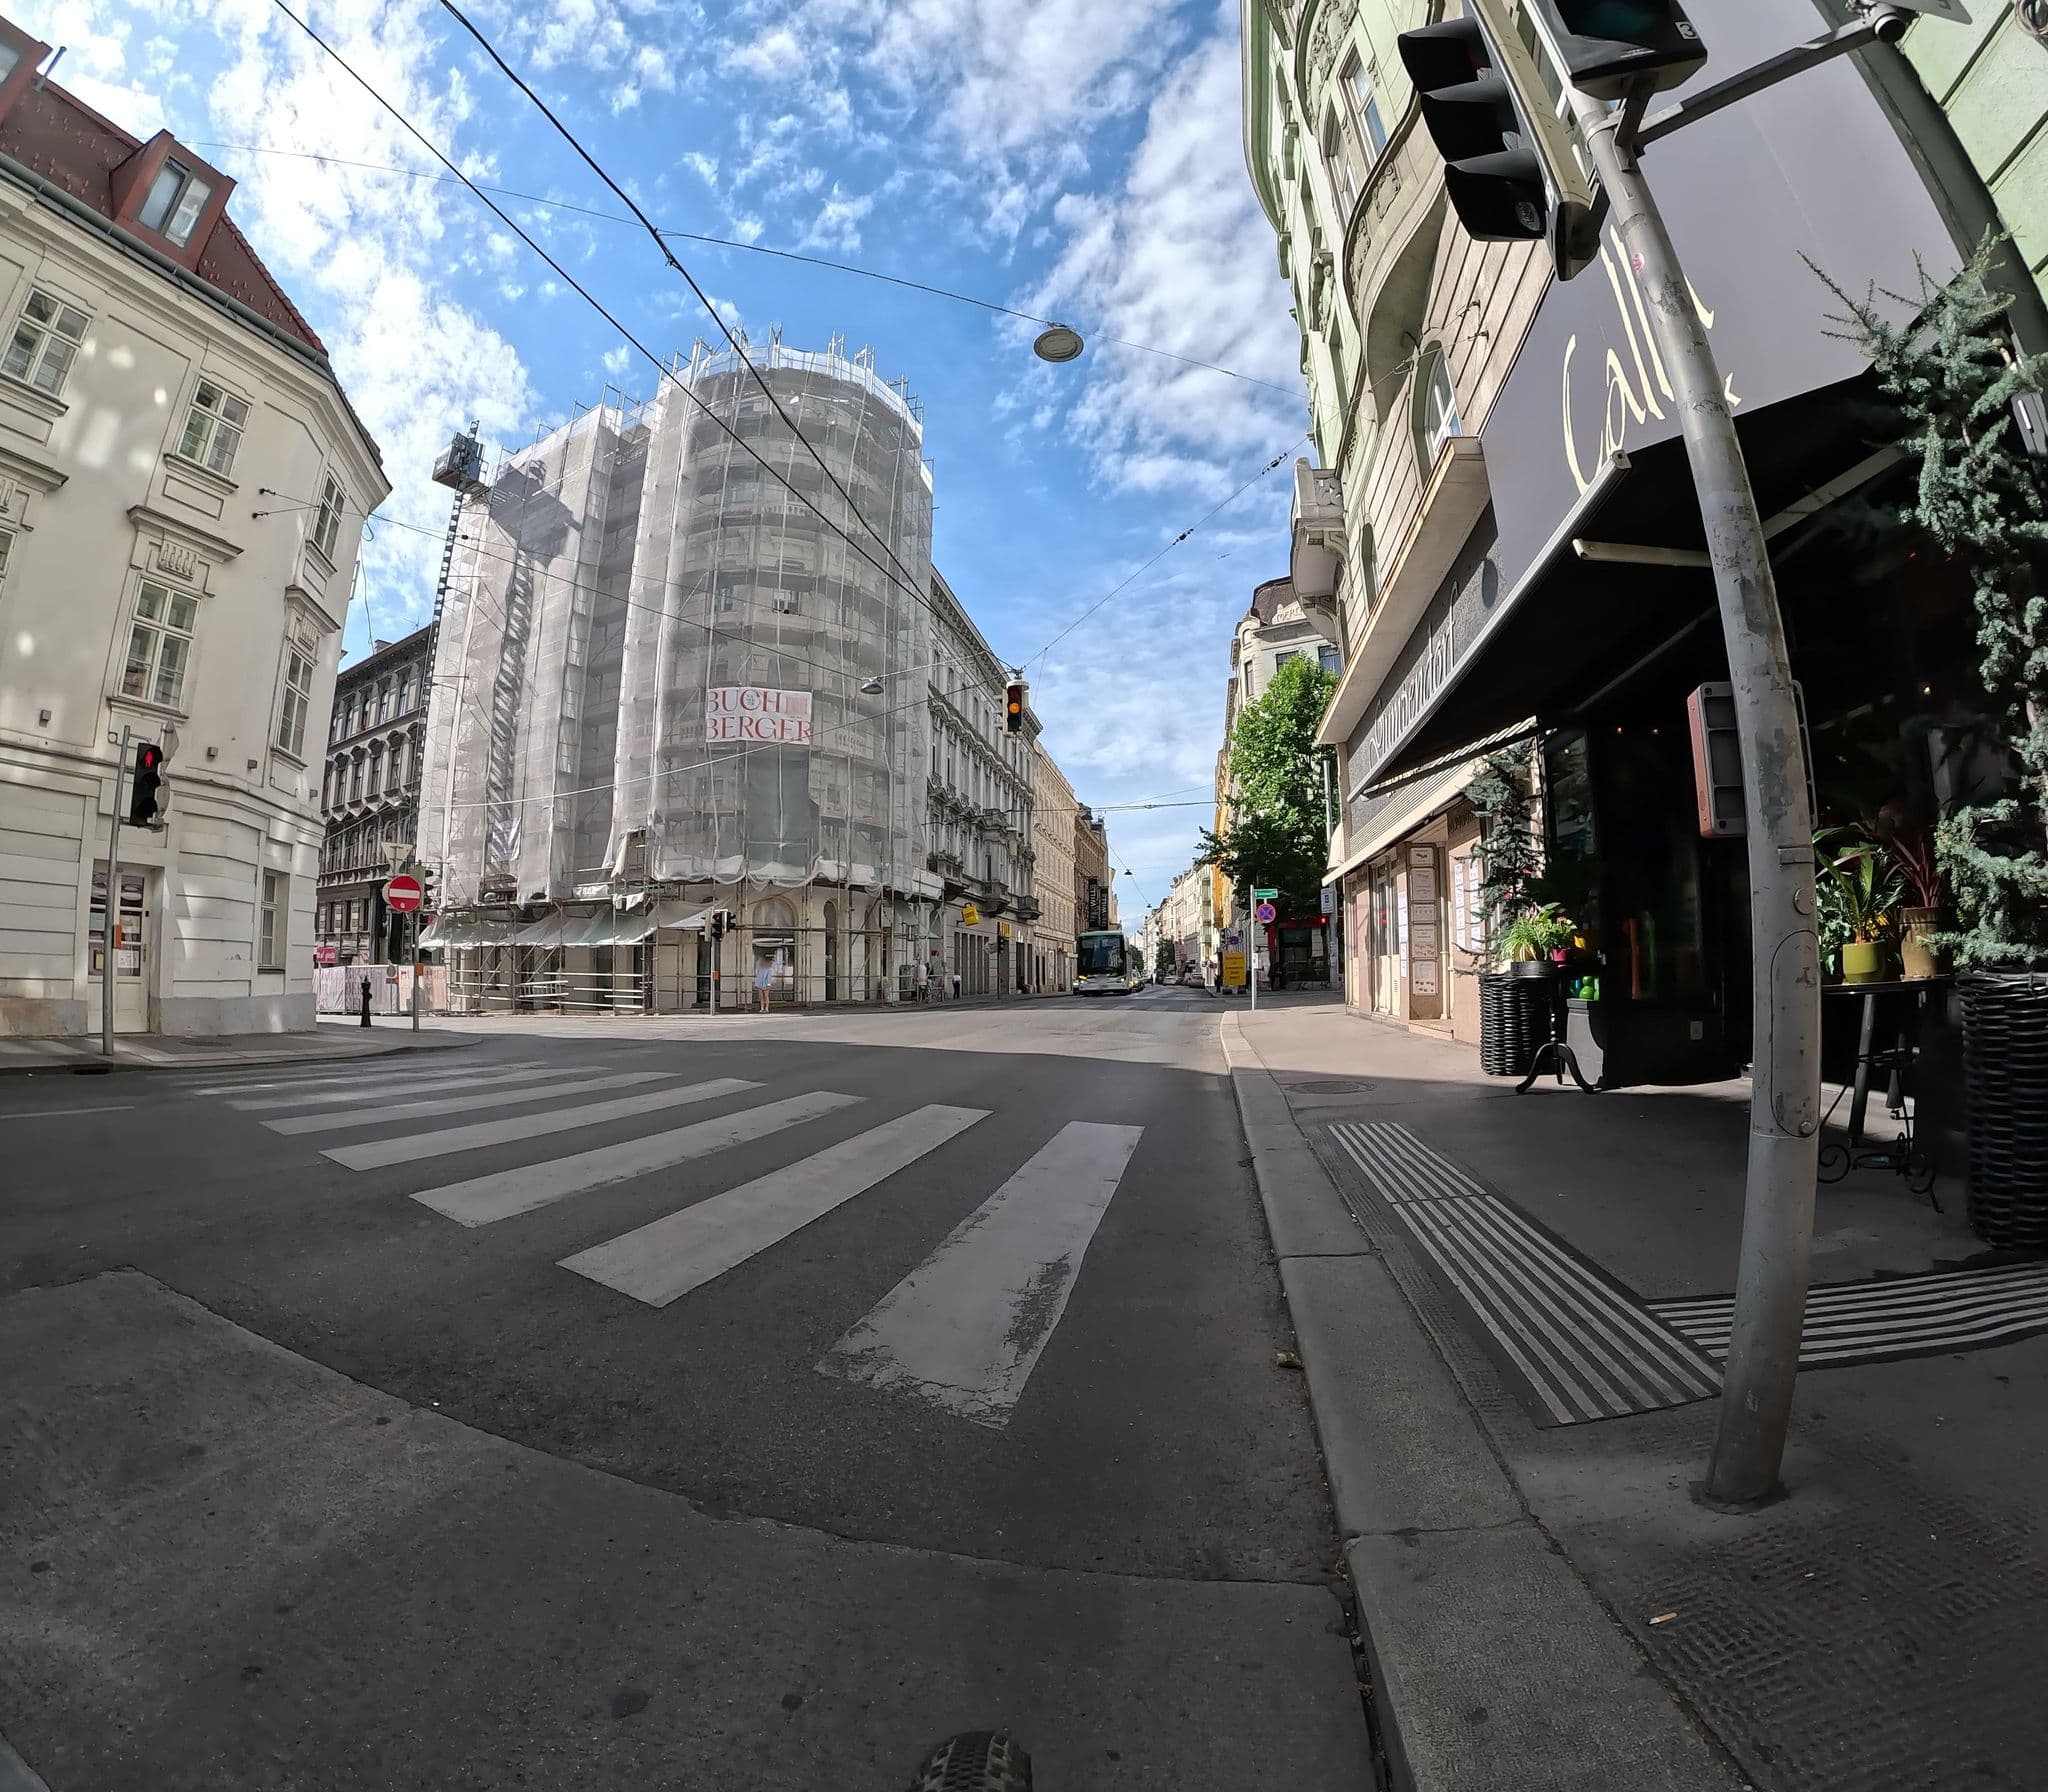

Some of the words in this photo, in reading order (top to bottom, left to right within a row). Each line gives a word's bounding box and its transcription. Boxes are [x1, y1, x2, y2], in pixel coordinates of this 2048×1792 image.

[1563, 224, 1715, 496] Call
[708, 689, 782, 713] BUCH
[707, 715, 811, 742] BERGER
